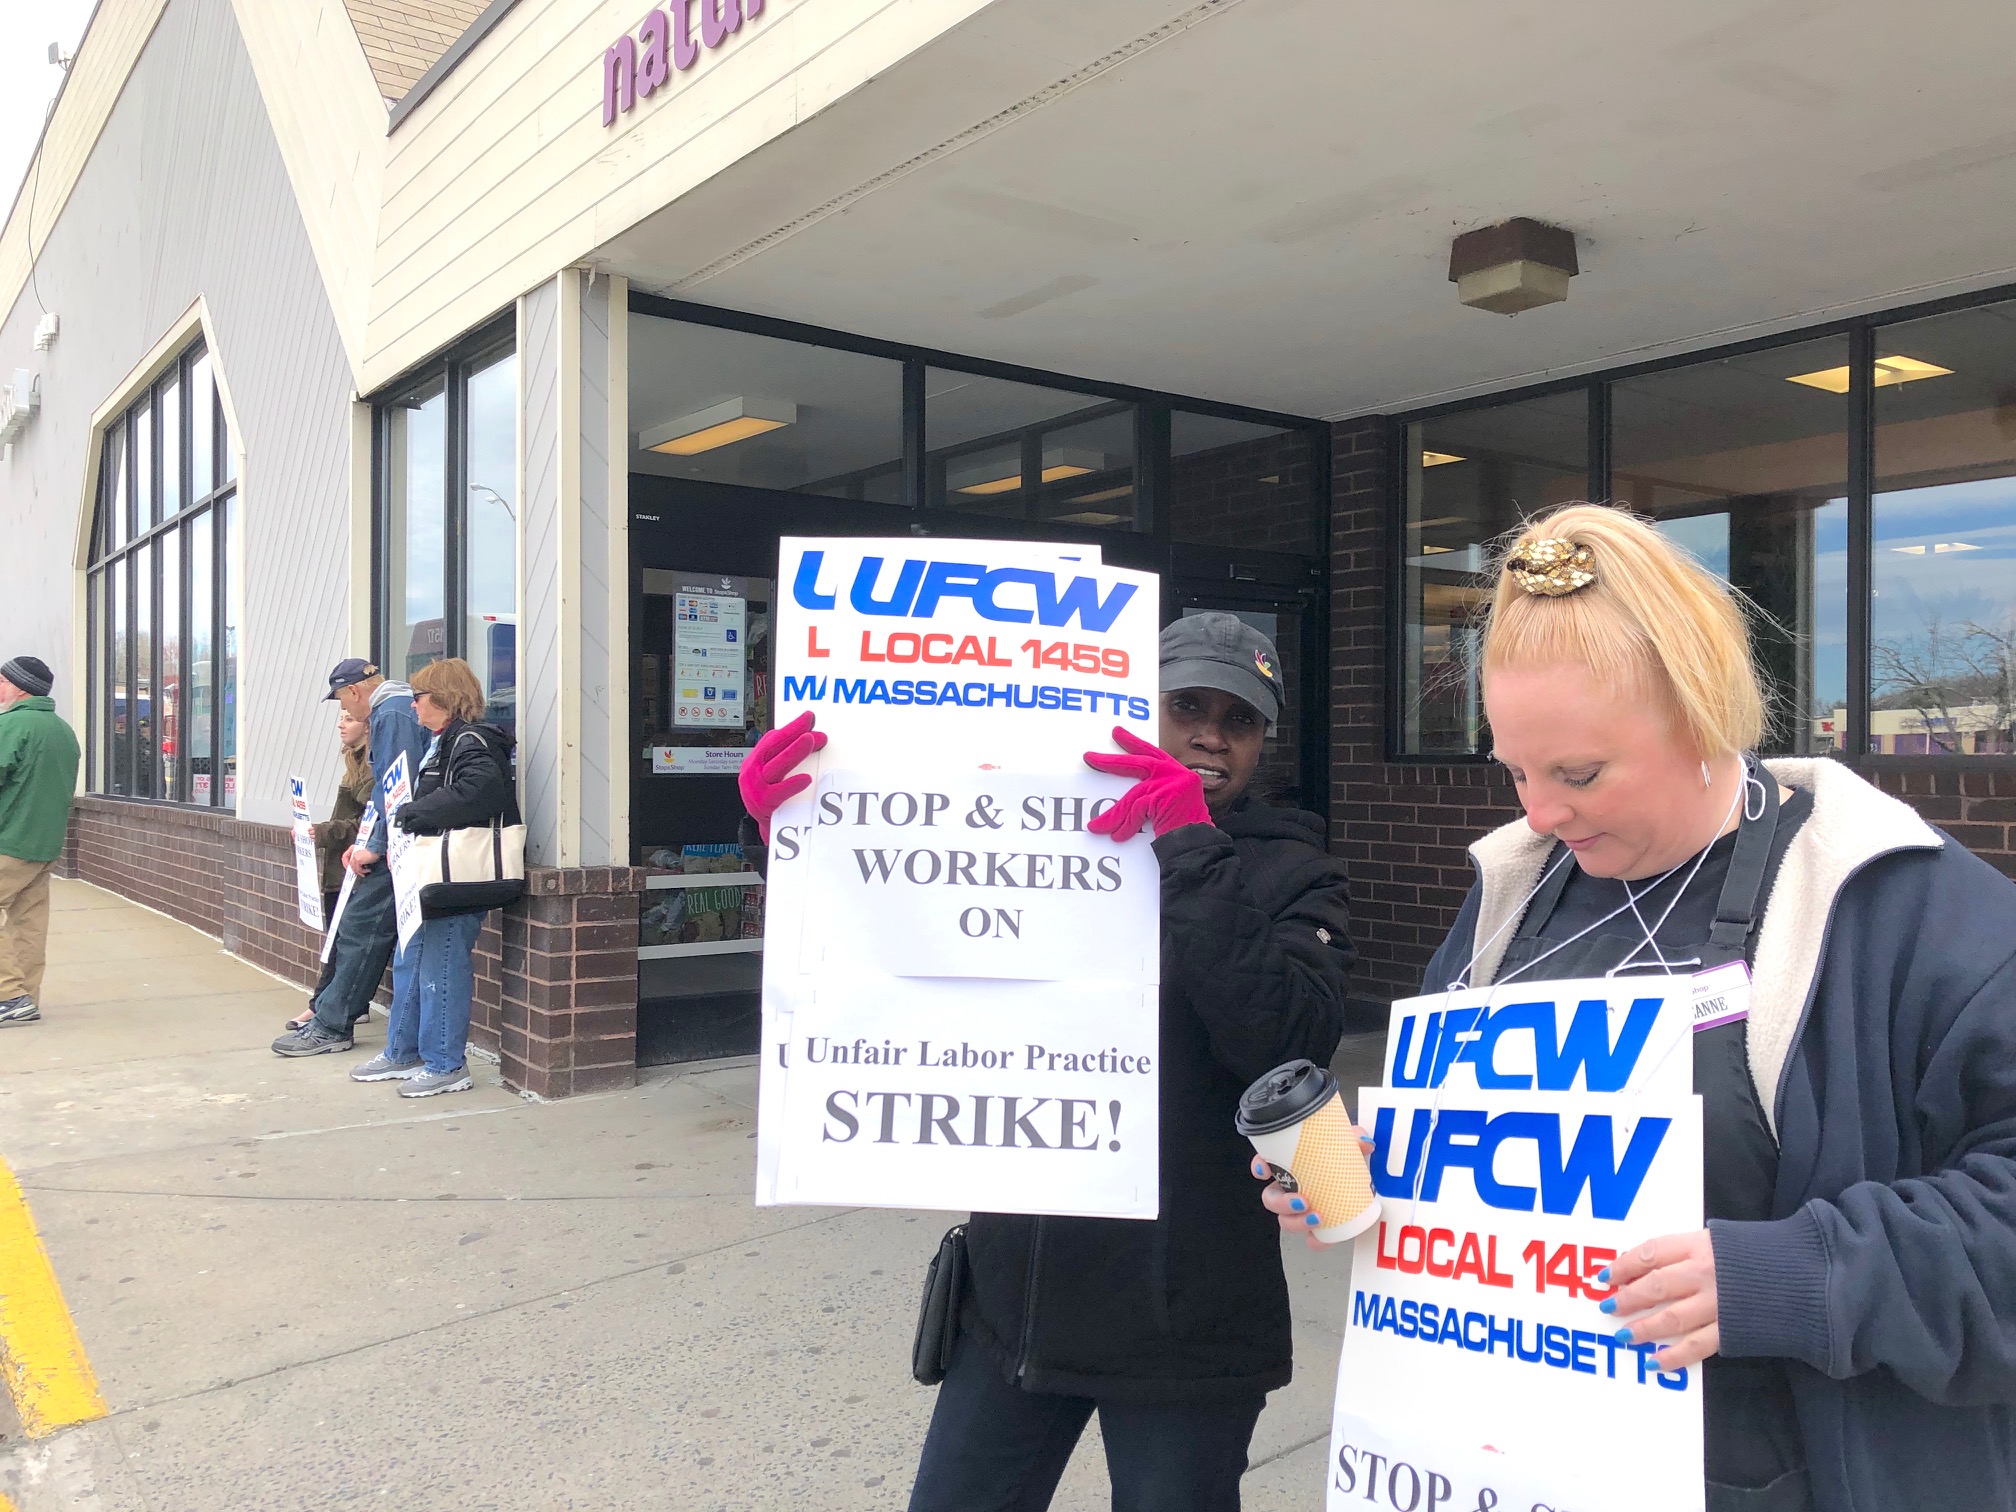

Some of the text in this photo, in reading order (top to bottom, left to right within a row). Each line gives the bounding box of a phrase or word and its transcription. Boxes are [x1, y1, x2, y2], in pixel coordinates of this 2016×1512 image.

[603, 0, 764, 128] natu
[682, 585, 705, 593] WELCOME
[849, 556, 1139, 633] UFCW
[859, 630, 1013, 668] LOCAL
[1020, 639, 1130, 679] 1459
[833, 678, 1150, 721] MASSACHUSETTS
[705, 750, 744, 758] Store Hours
[817, 791, 950, 827] STOP
[965, 794, 1005, 830] &
[851, 848, 1123, 892] WORKERS
[687, 886, 741, 915] REAL GOOD
[959, 907, 1024, 940] ON
[805, 1036, 908, 1066] Unfair
[917, 1040, 1014, 1070] Labor
[1024, 1044, 1152, 1075] Practice
[1391, 997, 1665, 1093] UFCW
[822, 1090, 1122, 1152] STRIKE!
[1370, 1107, 1673, 1221] UFCW
[1376, 1221, 1622, 1302] LOCAL 145
[1335, 1444, 1452, 1512] STOP
